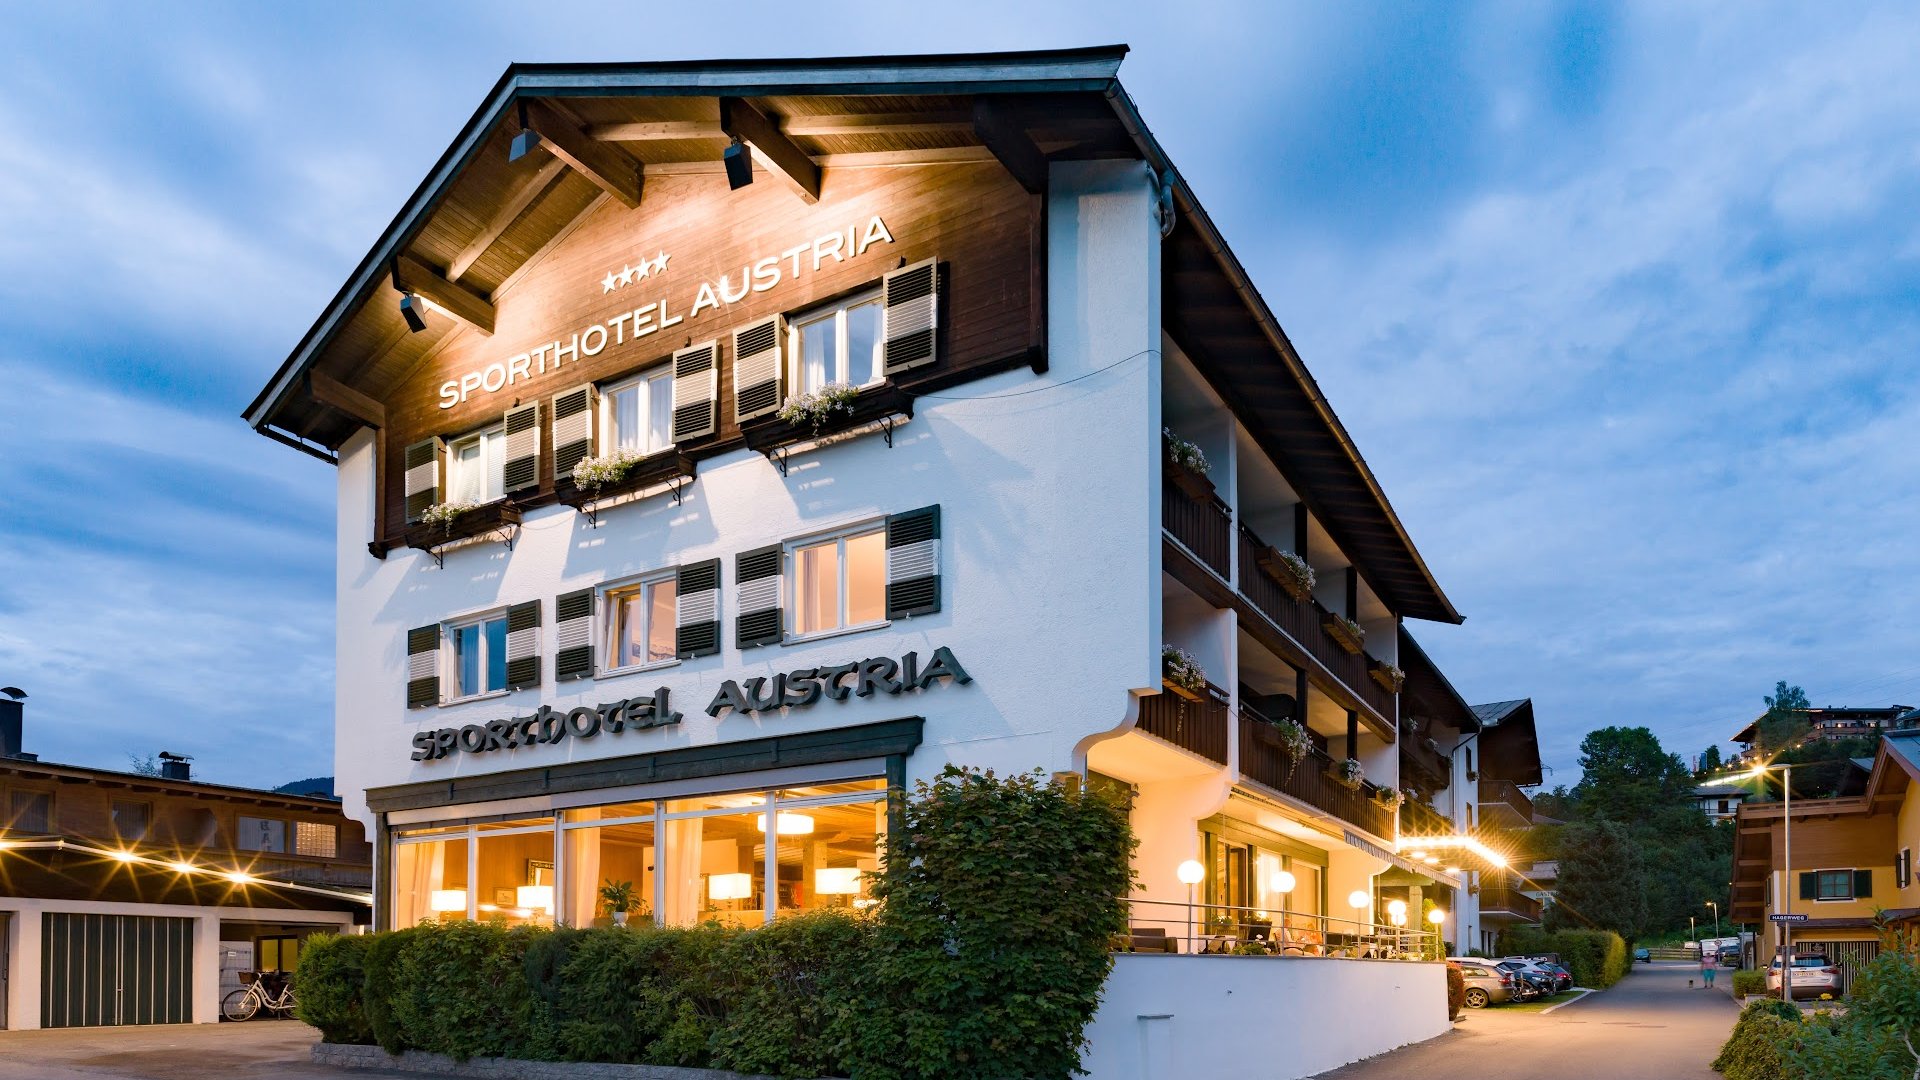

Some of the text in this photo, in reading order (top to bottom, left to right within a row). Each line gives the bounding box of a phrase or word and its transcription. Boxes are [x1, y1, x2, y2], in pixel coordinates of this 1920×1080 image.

[438, 215, 894, 411] SPORTHOTEL AUSTRIA
[705, 646, 973, 718] AUSTRIA
